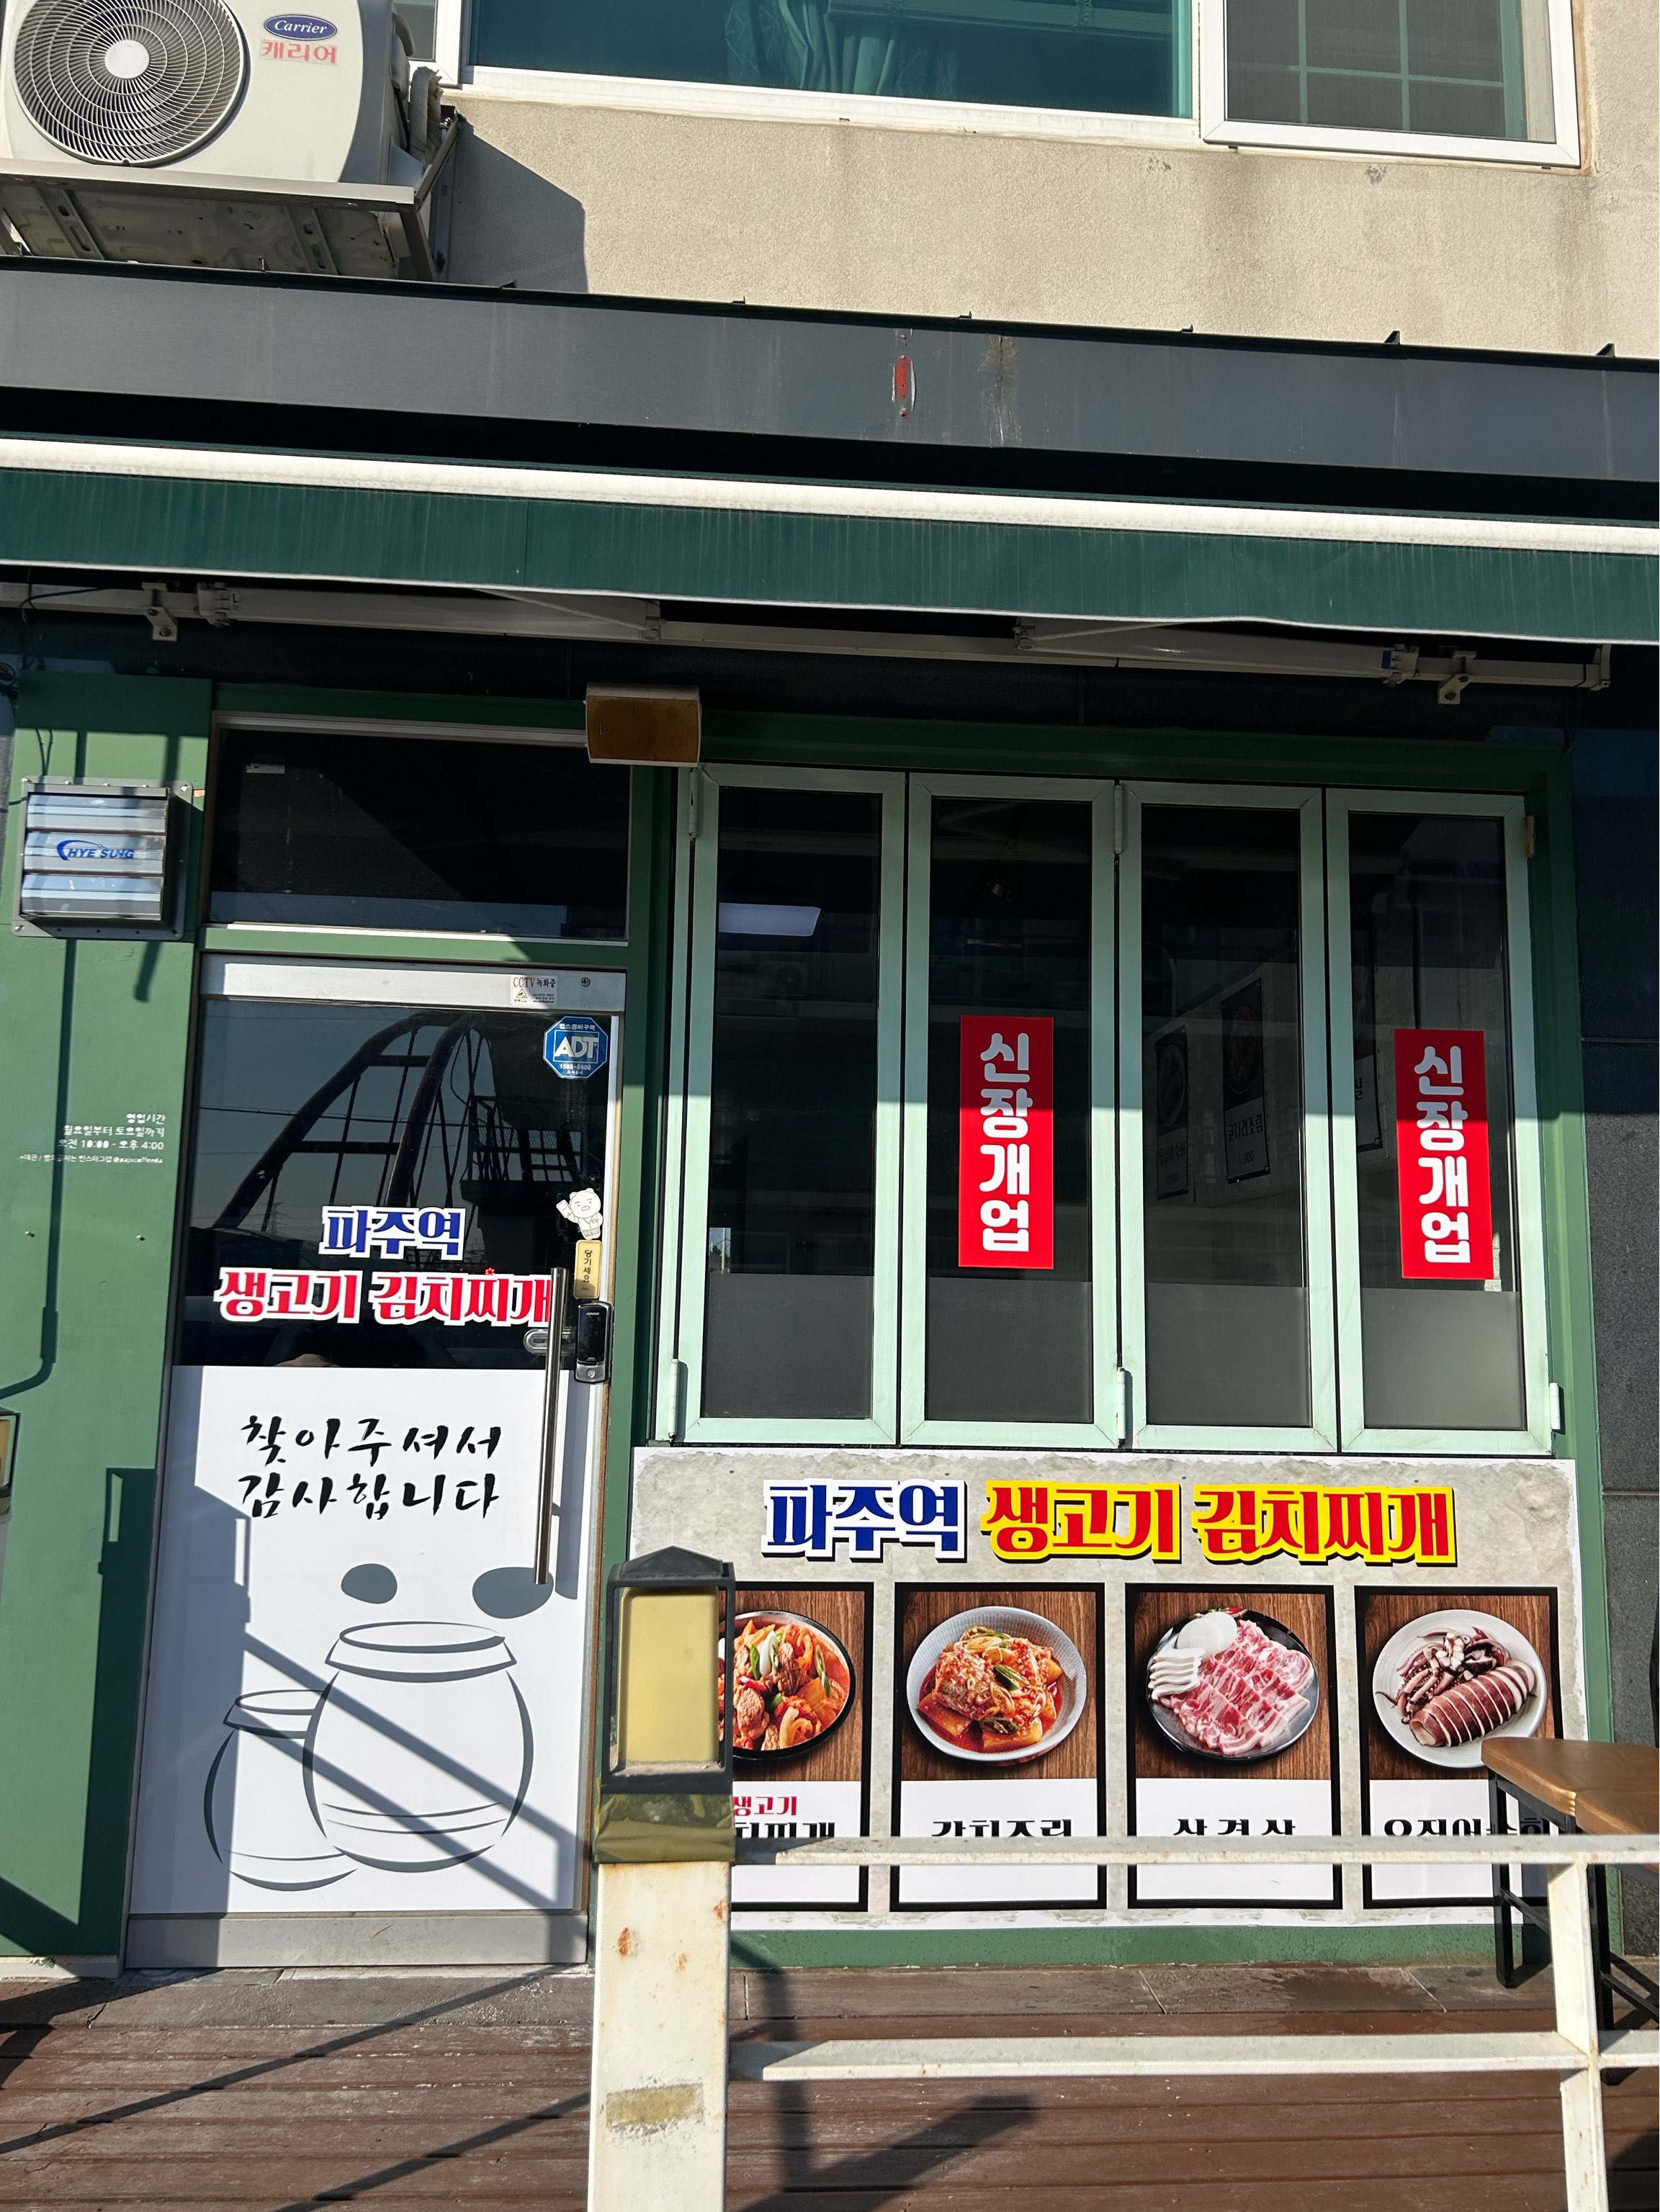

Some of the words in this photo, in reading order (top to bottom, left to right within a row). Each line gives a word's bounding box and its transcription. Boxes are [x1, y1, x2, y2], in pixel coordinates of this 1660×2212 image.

[274, 19, 327, 34] Carrier
[261, 41, 337, 64] 캐리어
[68, 848, 95, 858] HYE
[513, 976, 535, 988] CCTV
[536, 978, 557, 988] 녹화중
[555, 1035, 599, 1058] ADT
[64, 1124, 113, 1136] 월요일부터
[115, 1126, 165, 1138] 토요일까지
[126, 1113, 166, 1125] 영업시간
[57, 1138, 78, 1149] 오전
[118, 1139, 139, 1151] 오후
[141, 1141, 164, 1150] 4:00
[979, 1032, 1033, 1253] 신장개업
[1414, 1046, 1471, 1264] 신장개업
[322, 1208, 463, 1257] 파주역
[582, 1249, 593, 1283] 당기세요
[217, 1269, 359, 1321] 생고기
[373, 1274, 551, 1324] 김치찌개
[240, 1414, 502, 1467] 찾아주셔서
[238, 1473, 500, 1520] 감사합니다
[763, 1481, 964, 1557] 파주역
[984, 1483, 1178, 1560] 생고기
[1195, 1486, 1451, 1561] 김치찌개
